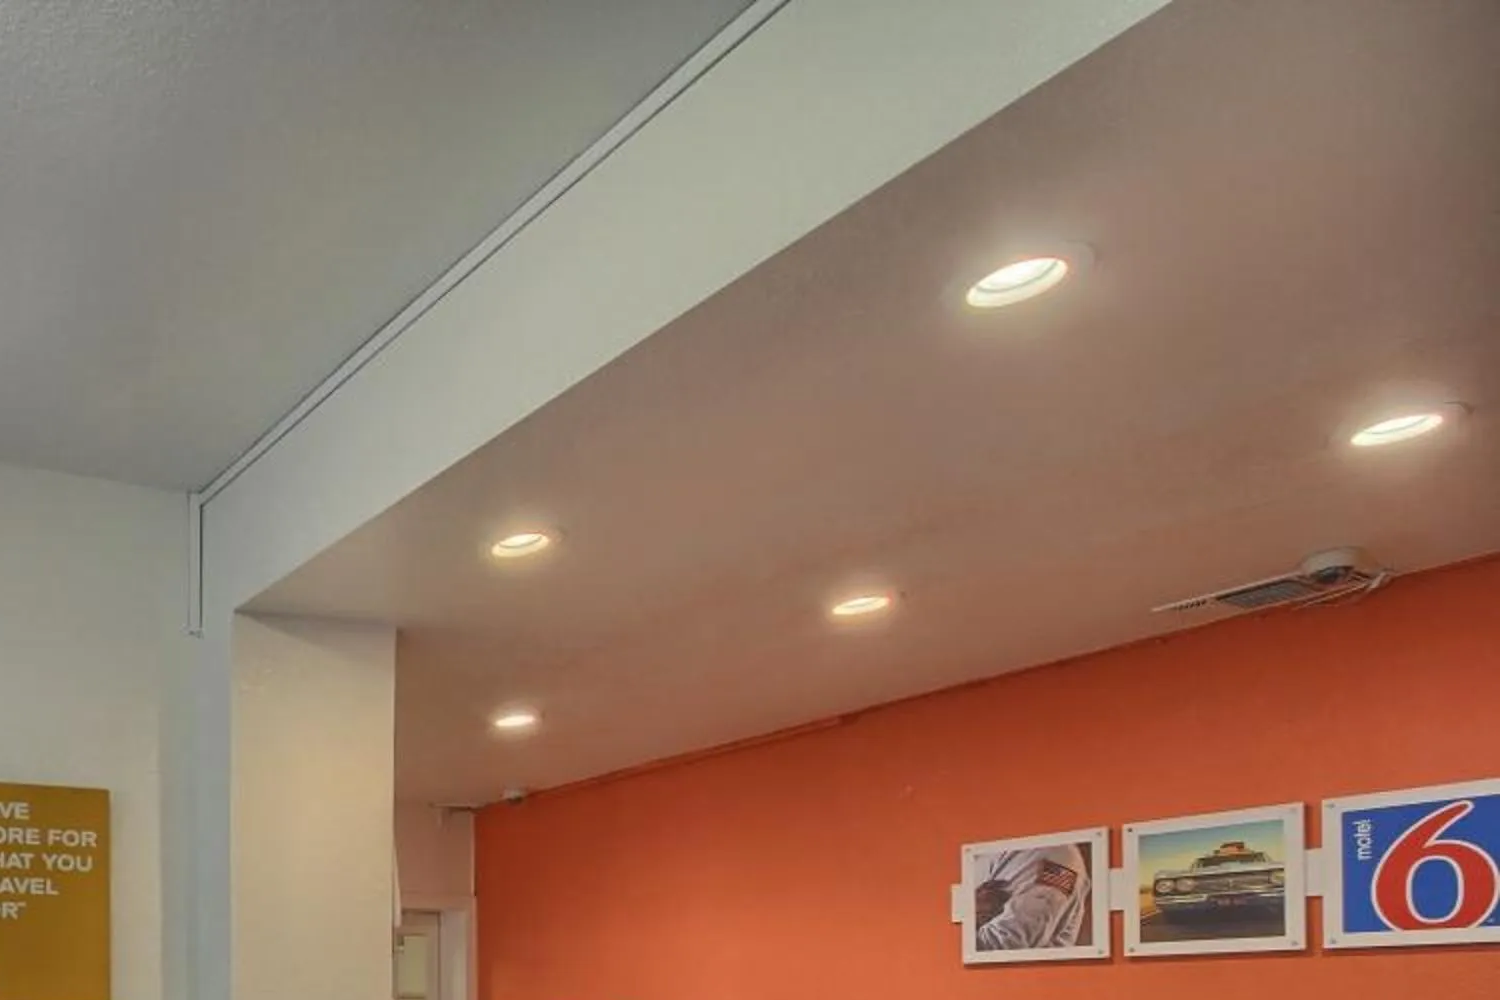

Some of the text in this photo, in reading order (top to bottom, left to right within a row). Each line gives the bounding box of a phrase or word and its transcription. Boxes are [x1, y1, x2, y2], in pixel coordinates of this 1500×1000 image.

[47, 829, 97, 848] FOR
[1352, 818, 1372, 861] motel
[41, 853, 93, 872] YOU
[1371, 800, 1500, 930] 6
